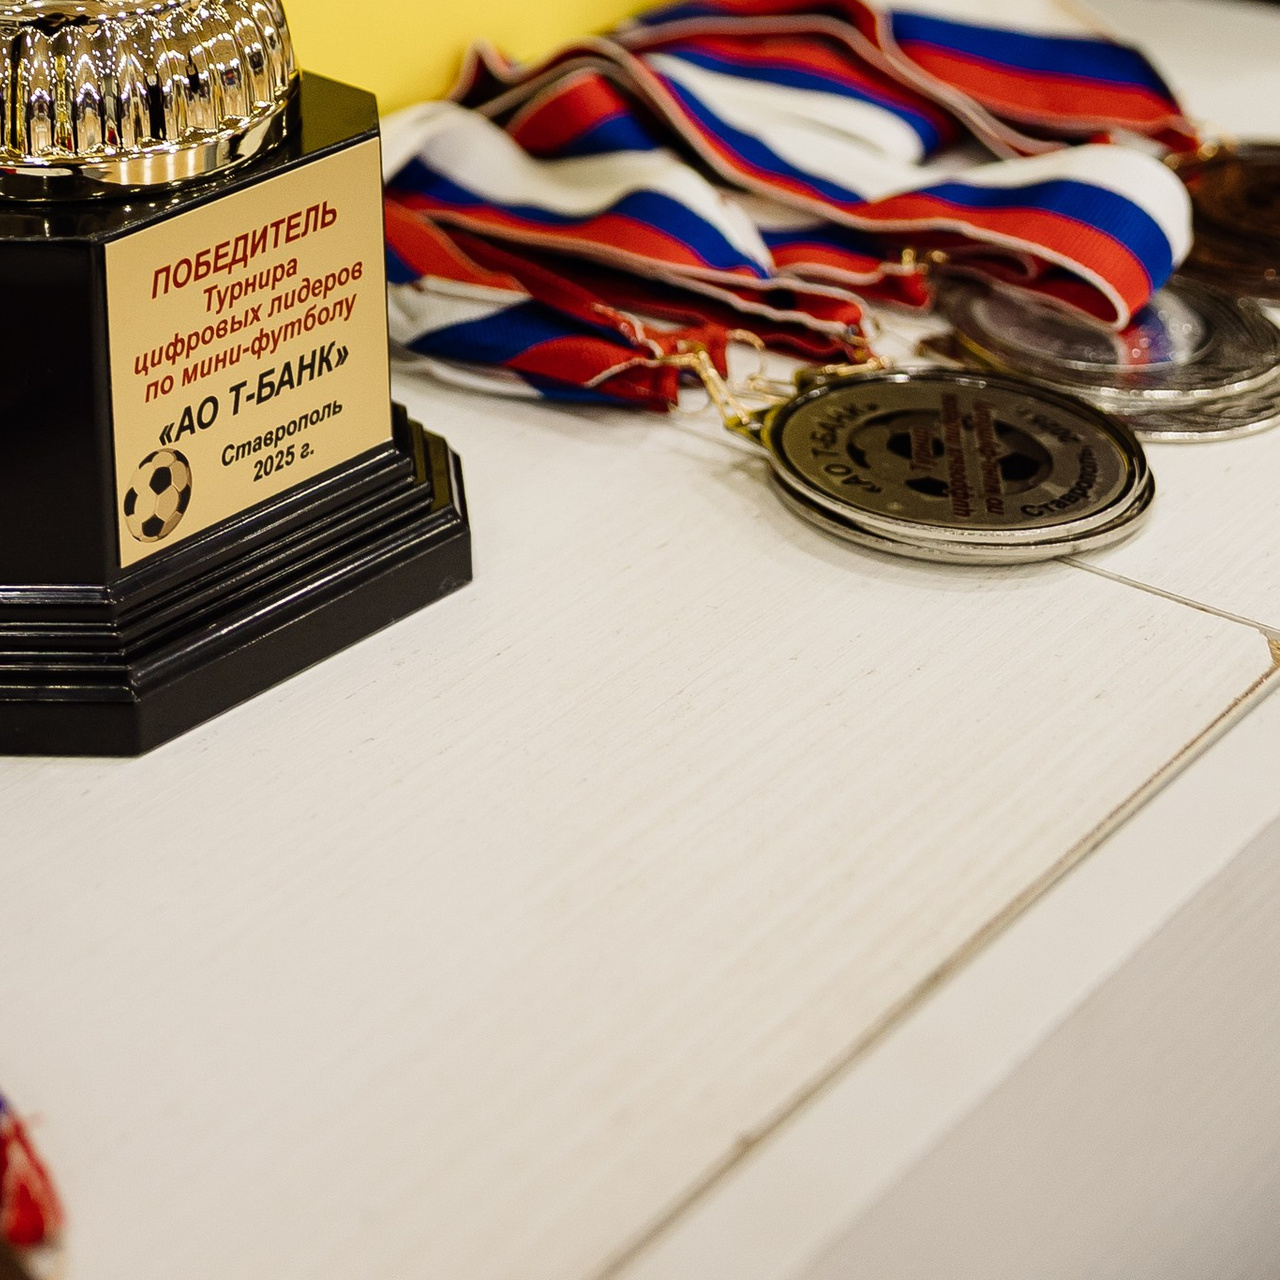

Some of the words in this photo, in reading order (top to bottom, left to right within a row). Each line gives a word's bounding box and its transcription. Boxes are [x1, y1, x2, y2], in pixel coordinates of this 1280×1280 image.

[151, 200, 338, 299] ПОБЕДИТЕЛЬ
[202, 258, 299, 315] Турнира
[133, 308, 262, 376] цифровых
[267, 260, 364, 319] лидеров
[144, 373, 174, 404] по
[181, 293, 359, 388] мини-футболу
[158, 395, 219, 446] «АО
[228, 341, 350, 417] Т-БАНК»
[221, 398, 344, 468] Ставрополь
[252, 444, 295, 483] 2025
[300, 441, 316, 462] г.
